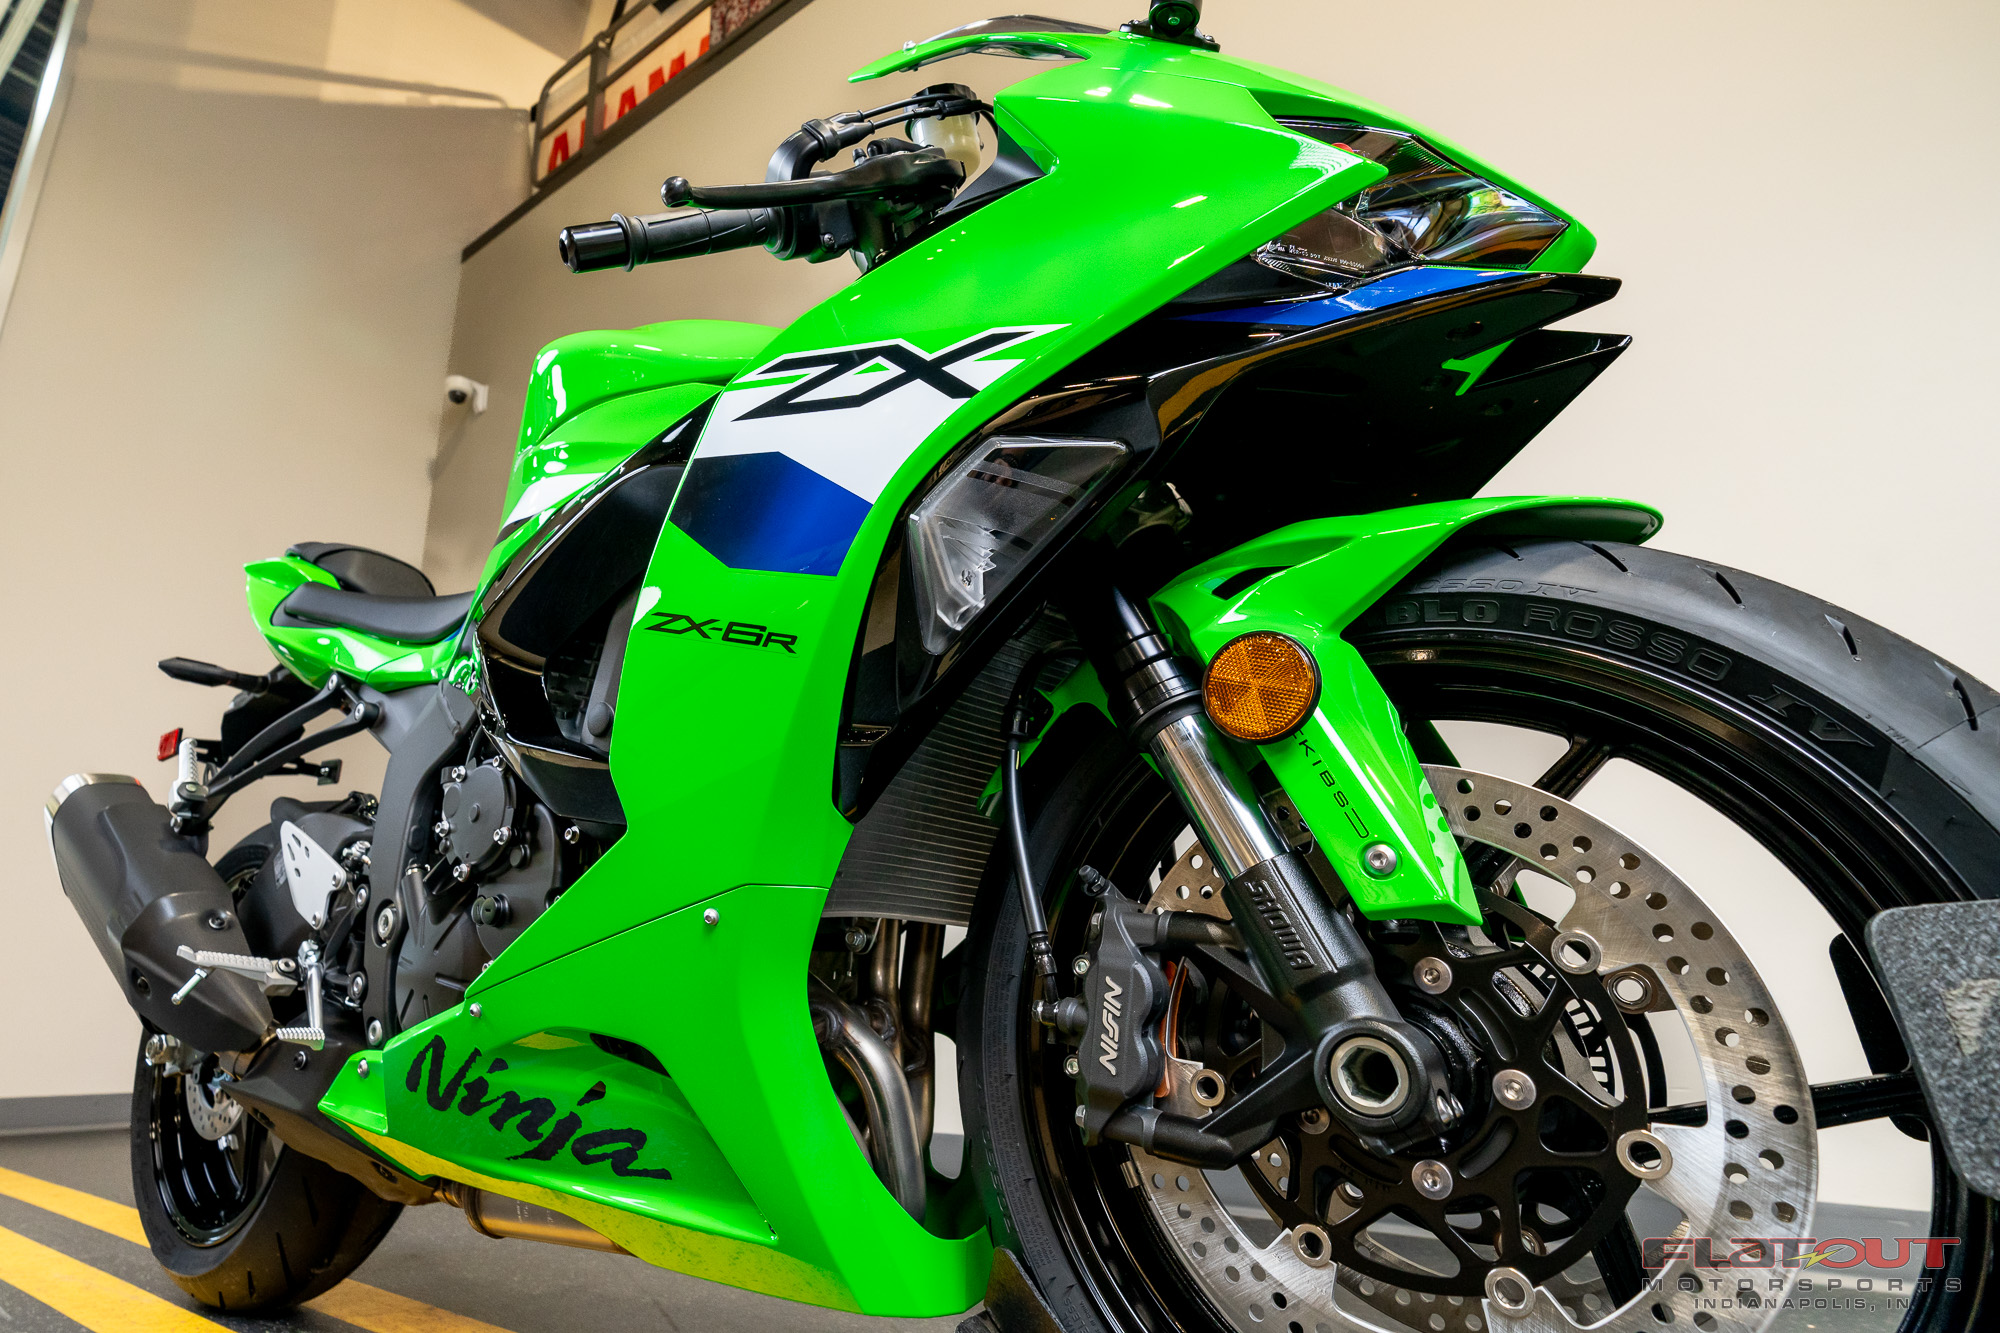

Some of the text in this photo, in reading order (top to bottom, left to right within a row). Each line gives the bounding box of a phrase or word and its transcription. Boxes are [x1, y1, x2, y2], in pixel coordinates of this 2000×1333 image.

[731, 331, 1035, 422] ZX
[1416, 579, 1524, 591] OSSO
[644, 612, 797, 654] ZX-6R
[1385, 599, 1500, 626] BLO
[1522, 603, 1734, 682] ROSSO
[1244, 879, 1315, 971] SHOWA
[405, 1034, 673, 1180] Ninja
